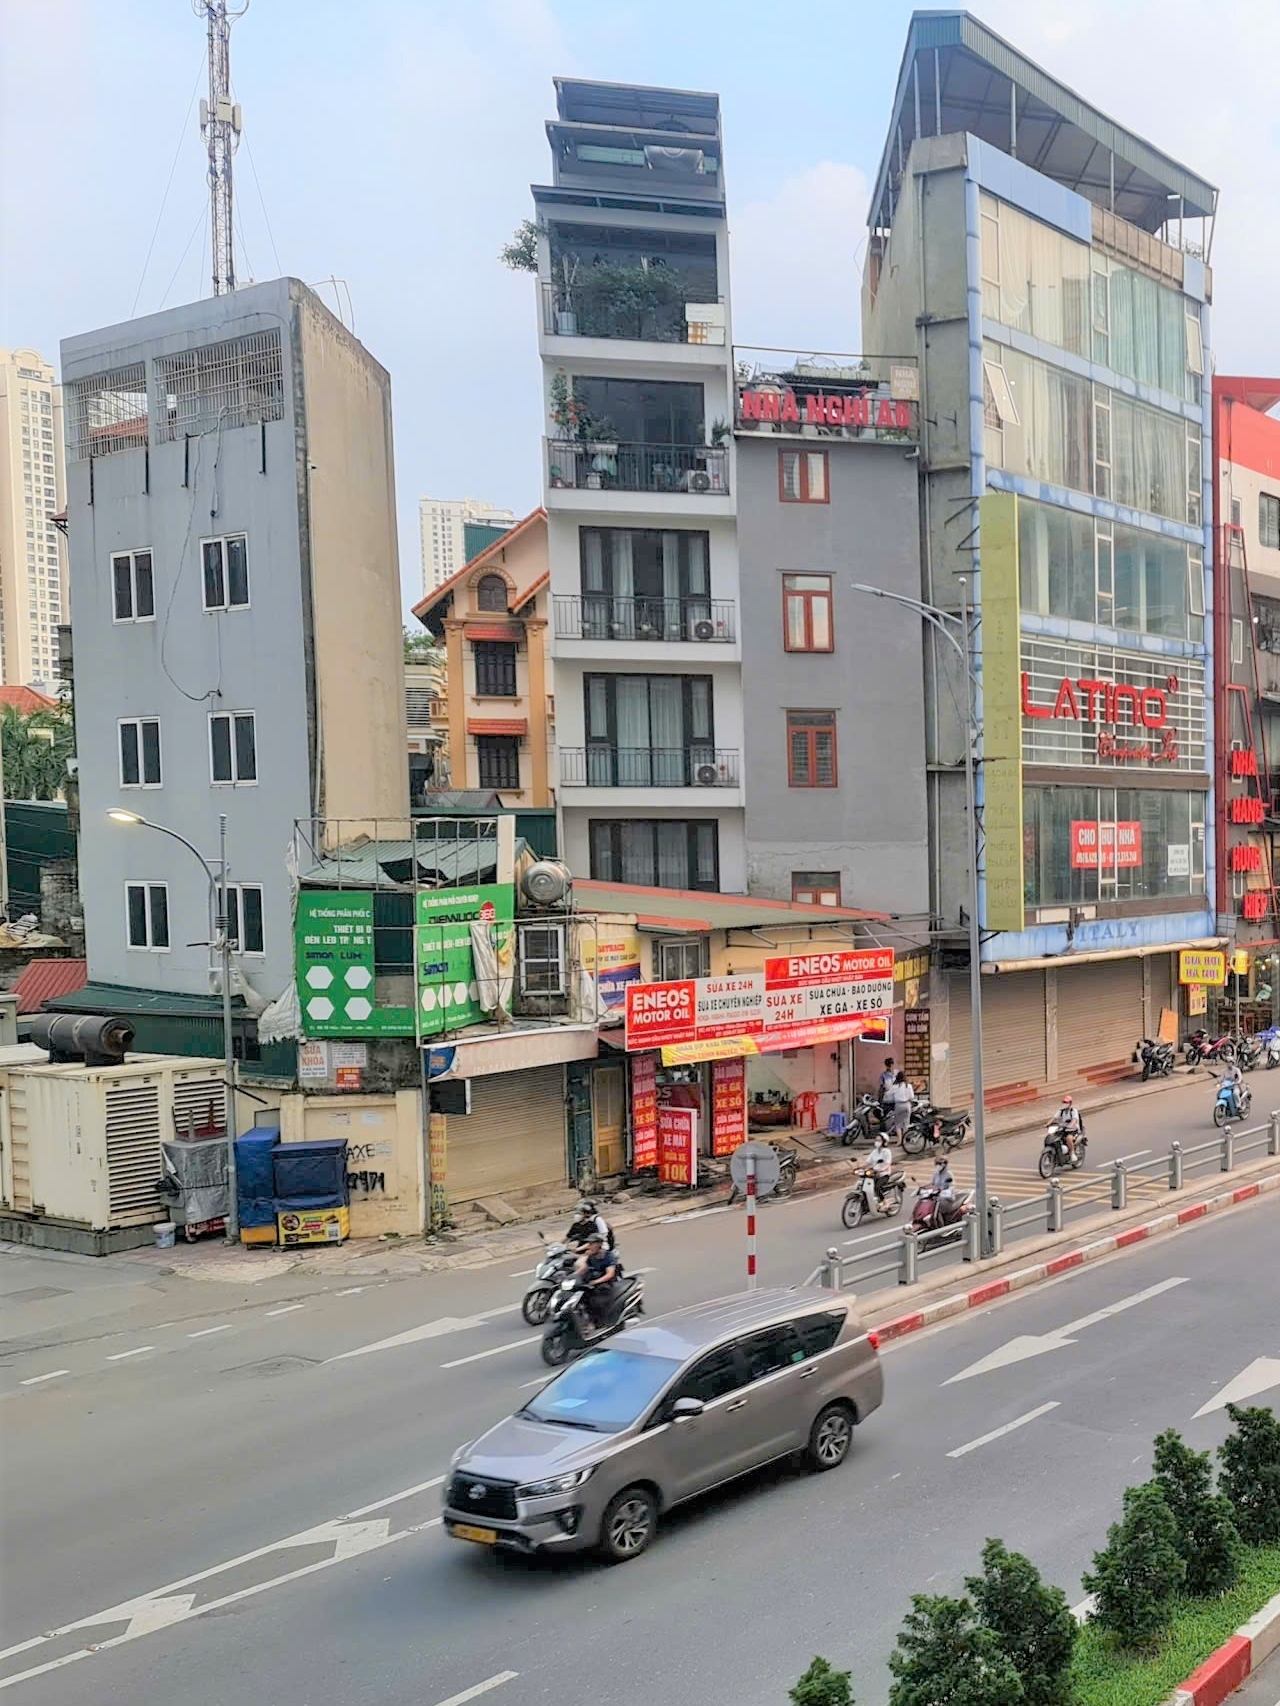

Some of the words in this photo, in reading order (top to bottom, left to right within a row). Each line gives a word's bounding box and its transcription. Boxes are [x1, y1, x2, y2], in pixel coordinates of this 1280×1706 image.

[1079, 828, 1095, 845] CHO
[1079, 922, 1139, 942] ITALY
[322, 936, 336, 944] LED
[788, 955, 840, 977] ENEOS
[843, 957, 875, 972] MOTOR
[877, 956, 892, 968] OIL
[707, 980, 723, 993] SỬA
[726, 982, 737, 992] XE
[738, 981, 753, 991] 24H
[632, 988, 690, 1011] ENEOS
[710, 1000, 718, 1010] XE
[766, 994, 787, 1008] SỬA
[790, 993, 802, 1005] XE
[820, 1003, 832, 1016] XE
[835, 1003, 848, 1014] GA
[856, 1000, 868, 1011] XE
[870, 995, 883, 1009] SỐ
[633, 1011, 671, 1025] MOTOR
[673, 1008, 690, 1020] OIL
[775, 1009, 794, 1021] 24H
[716, 1082, 727, 1093] XE
[636, 1097, 645, 1108] XE
[716, 1098, 727, 1108] XE
[636, 1114, 645, 1125] XE
[664, 1134, 672, 1145] XE
[663, 1164, 688, 1181] 10K
